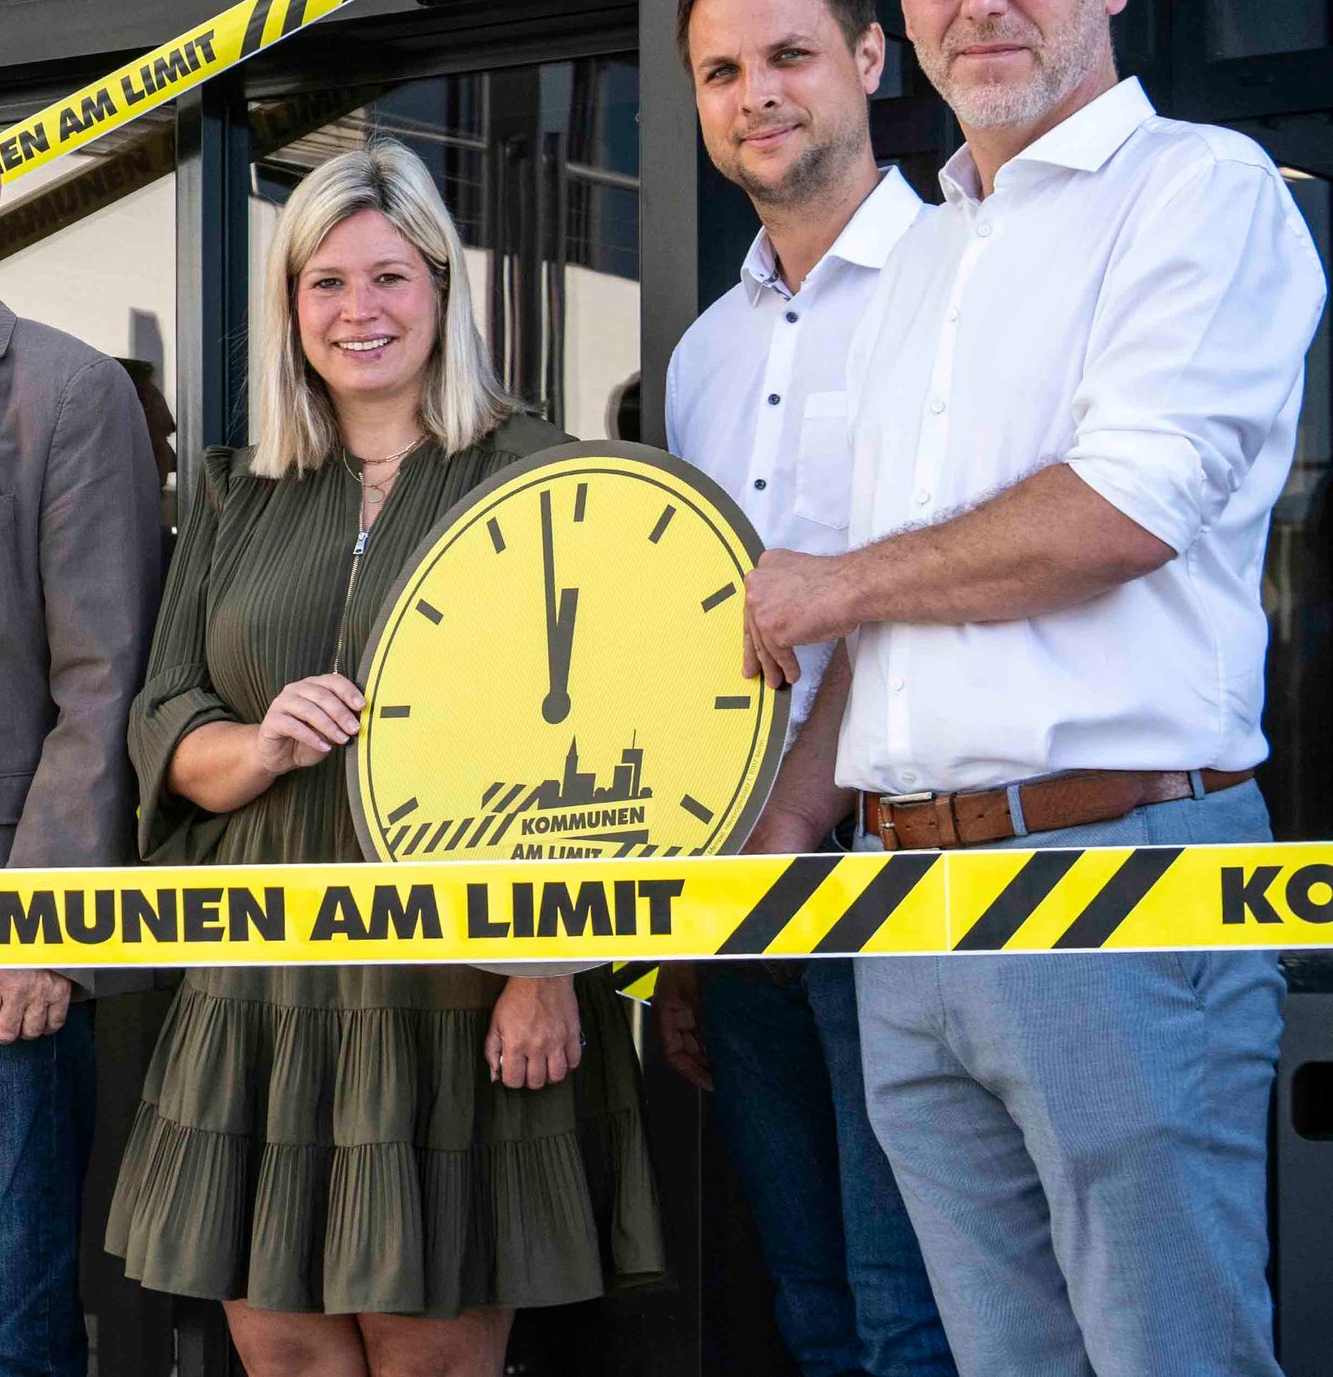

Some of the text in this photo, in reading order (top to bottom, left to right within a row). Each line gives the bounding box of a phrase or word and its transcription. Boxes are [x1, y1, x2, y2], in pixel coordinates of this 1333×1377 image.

[59, 87, 118, 143] AM
[121, 29, 217, 107] LIMIT
[521, 806, 645, 836] KOMMUNEN
[510, 843, 603, 860] AM LIMIT
[308, 883, 443, 943] AM
[466, 878, 686, 939] LIMIT
